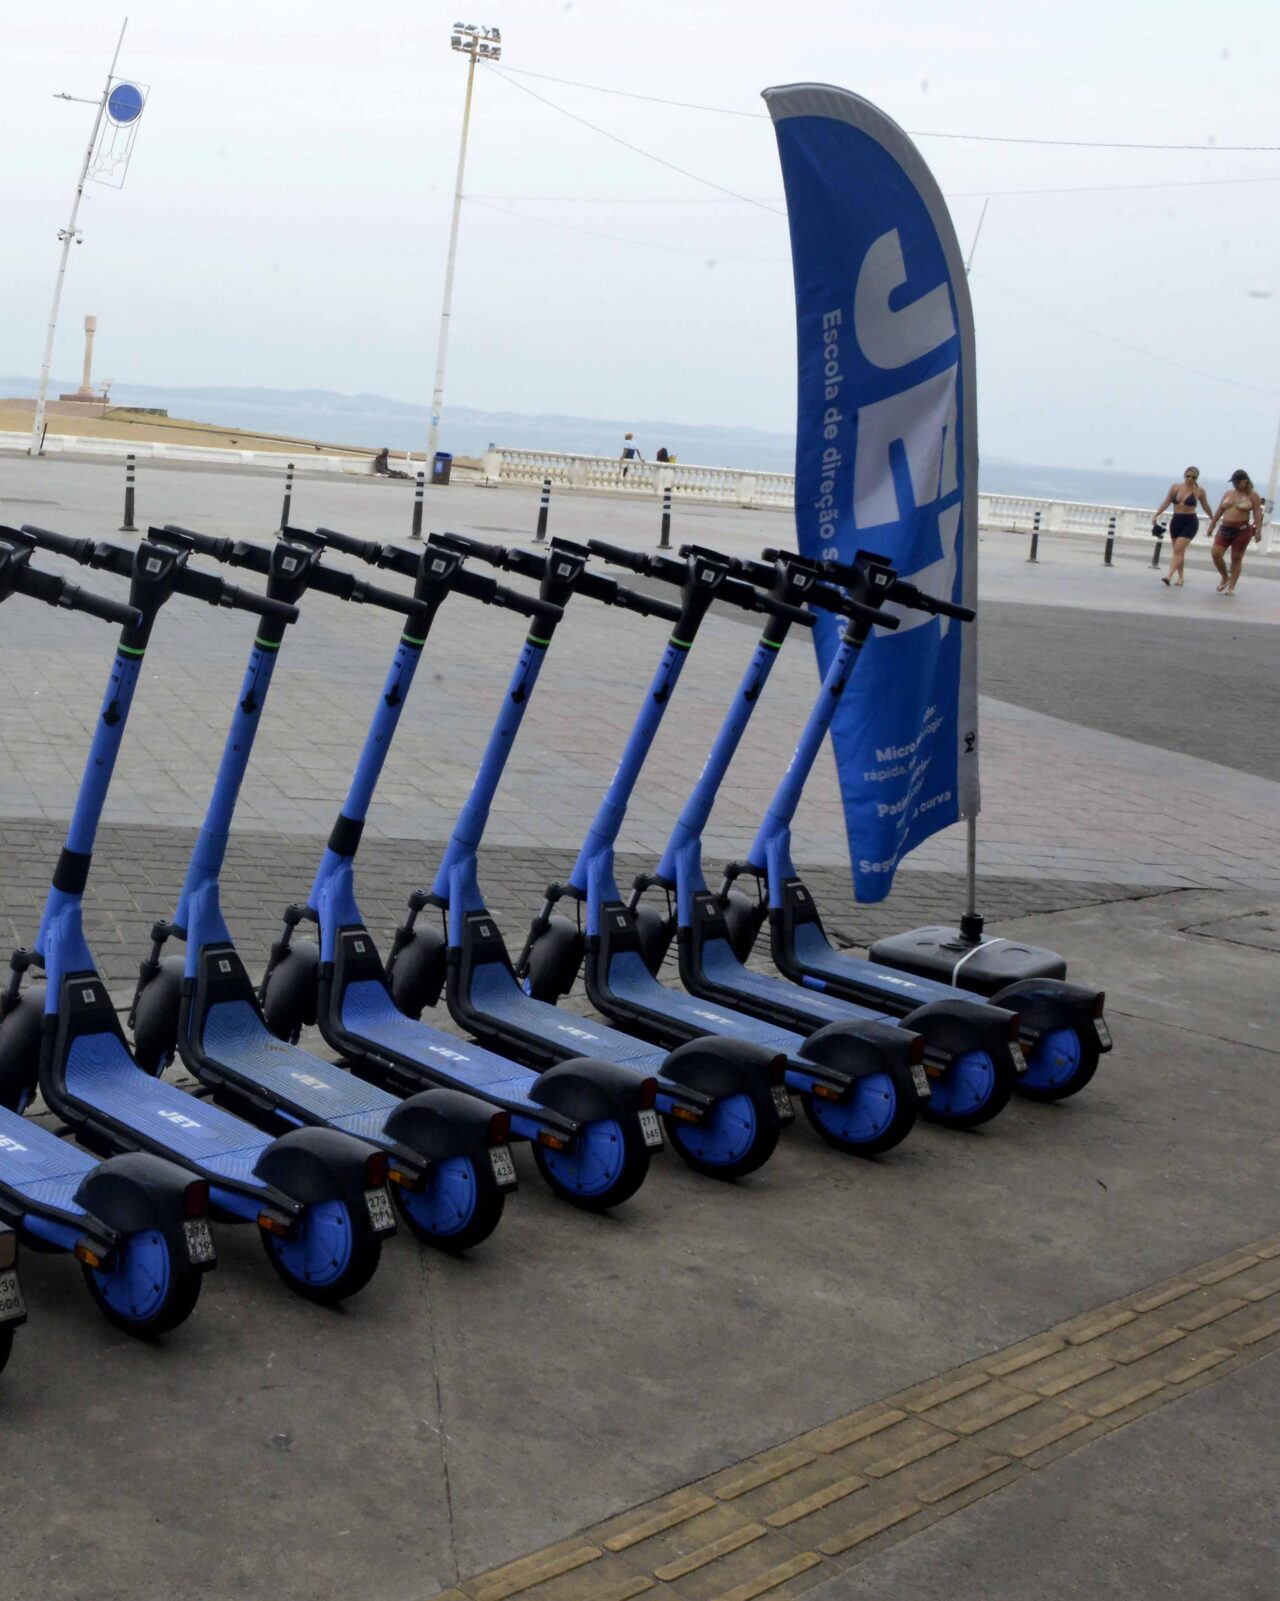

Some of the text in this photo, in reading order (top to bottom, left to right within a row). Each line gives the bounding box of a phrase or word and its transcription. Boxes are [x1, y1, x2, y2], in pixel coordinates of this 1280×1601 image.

[823, 308, 843, 401] Escola
[823, 406, 843, 440] de
[853, 227, 962, 639] JET
[814, 446, 841, 540] direção
[920, 791, 952, 813] curva
[557, 1024, 599, 1040] JET
[428, 1045, 470, 1061] JET
[290, 1072, 331, 1090] JET
[158, 1110, 202, 1128] JET
